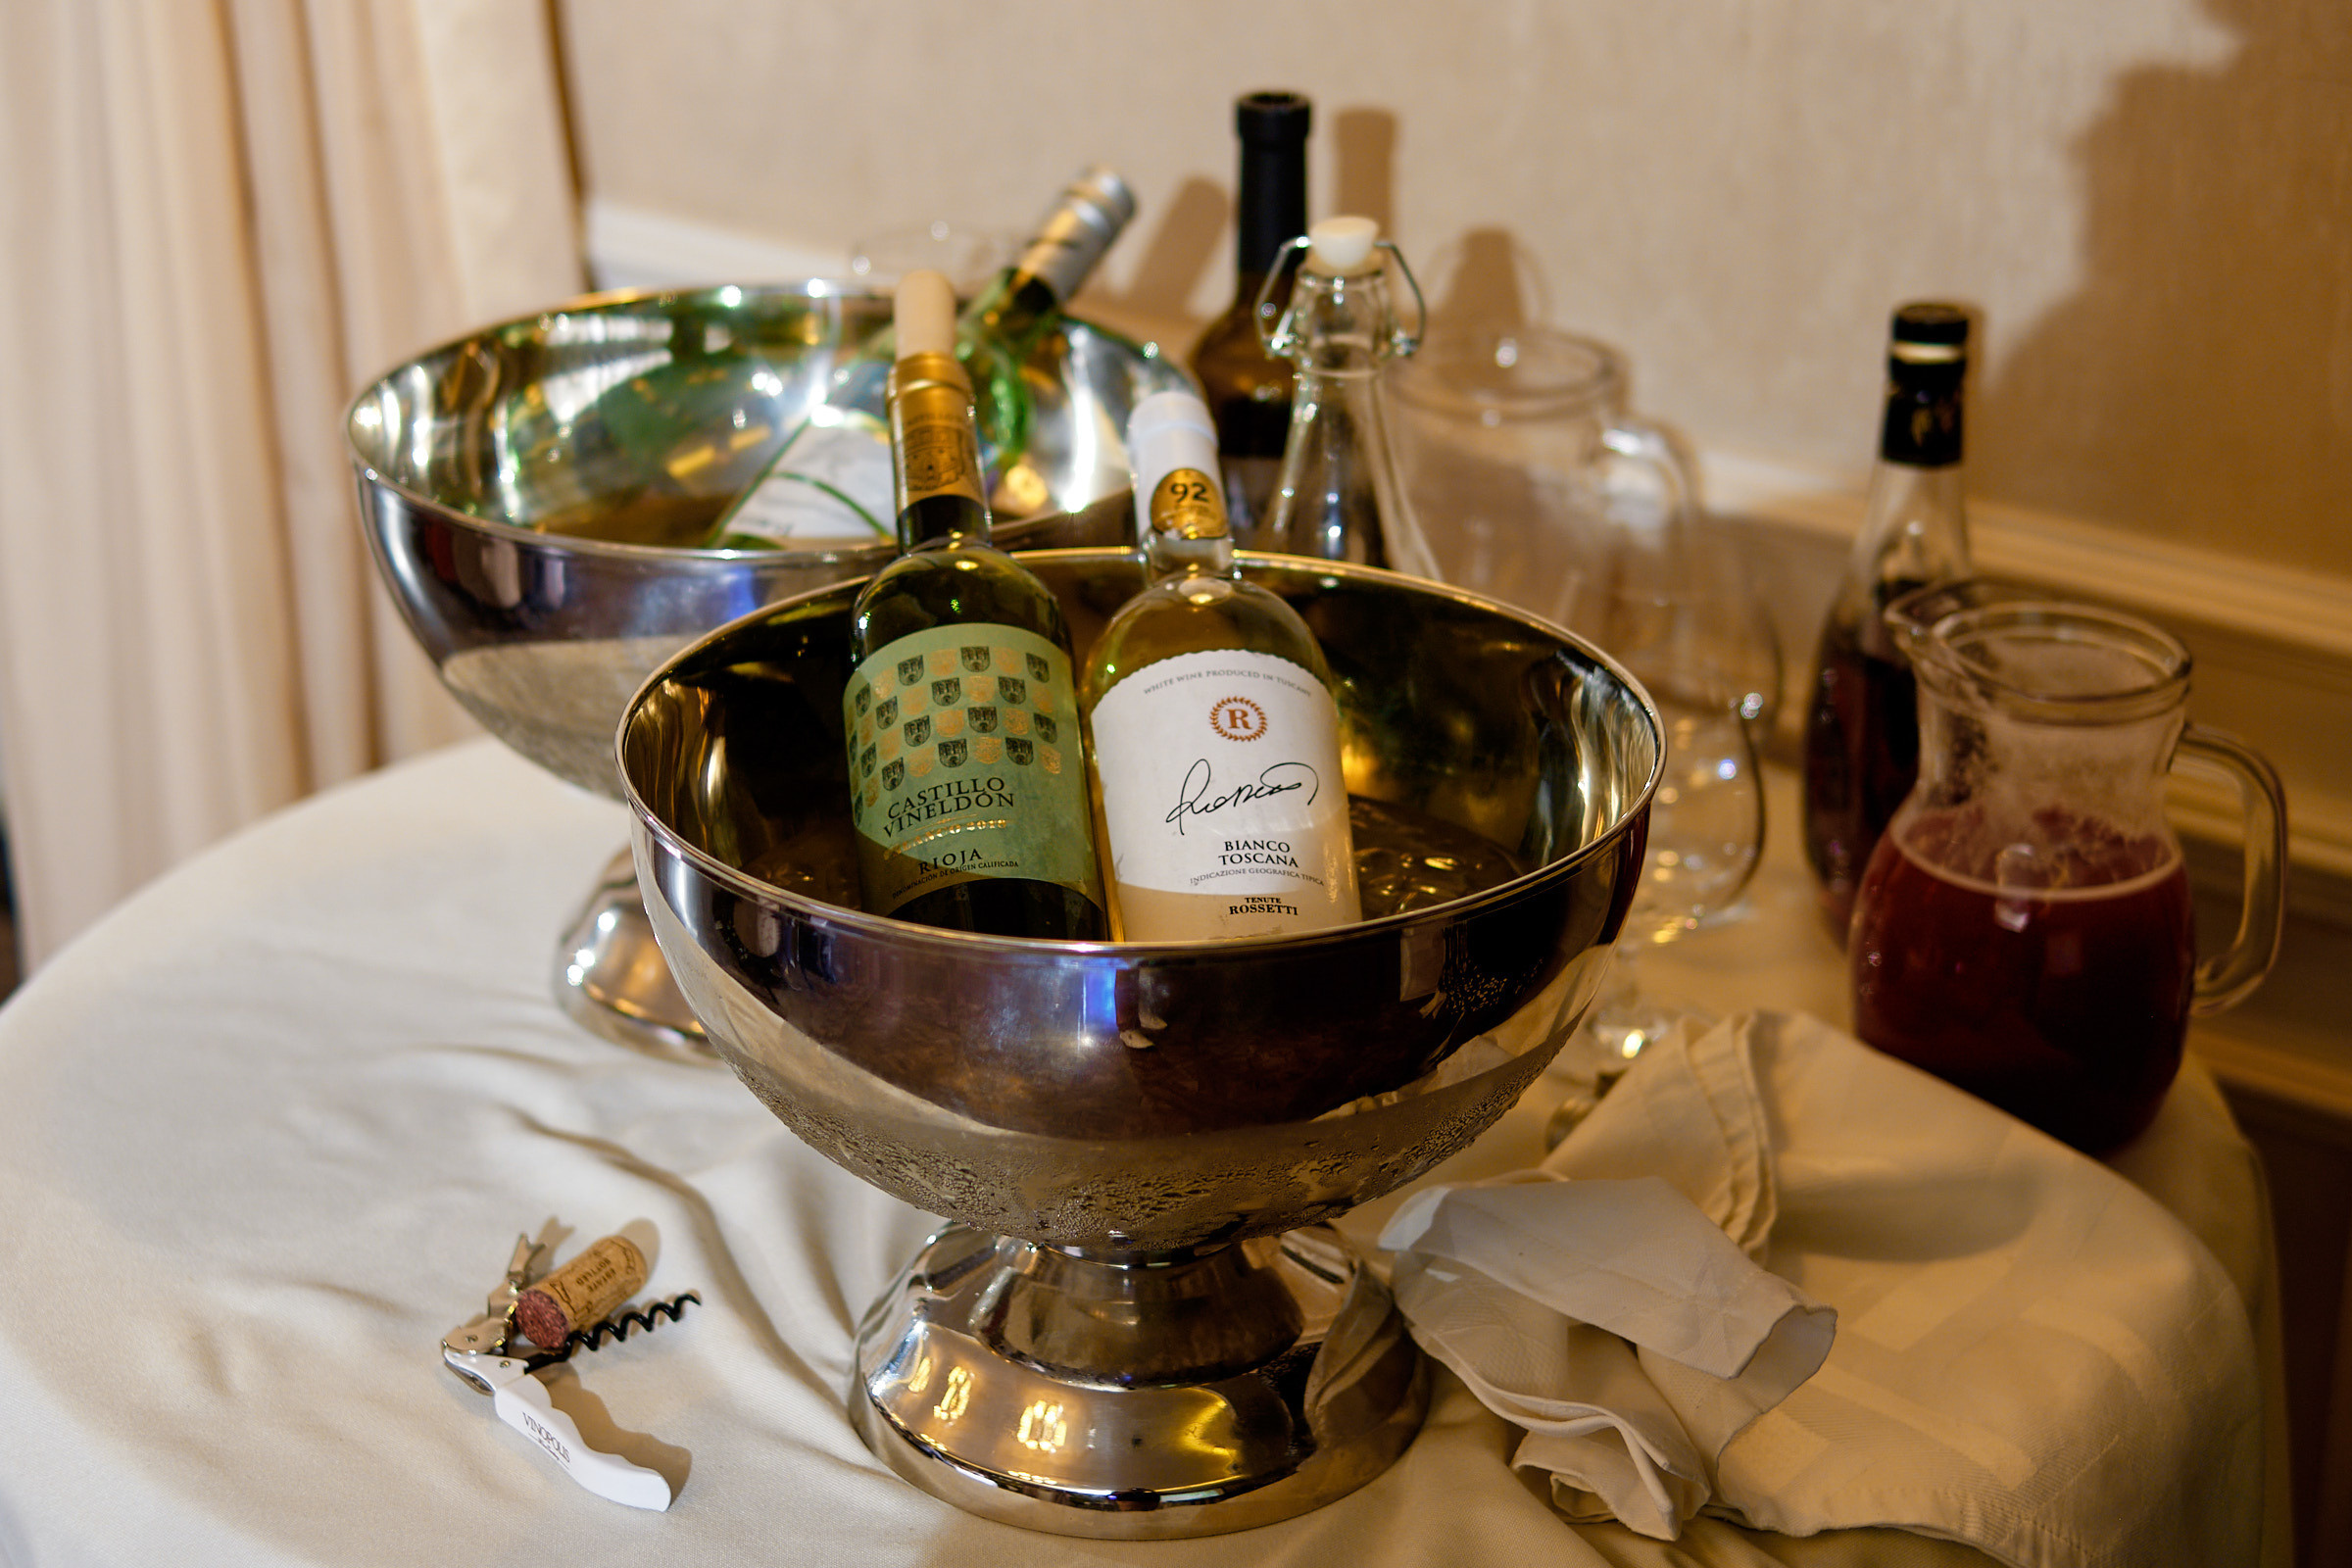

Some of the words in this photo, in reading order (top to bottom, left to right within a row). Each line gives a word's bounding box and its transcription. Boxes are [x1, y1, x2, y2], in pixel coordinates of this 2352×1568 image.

[1171, 482, 1209, 503] 92
[1144, 678, 1173, 694] WHITE
[1176, 671, 1202, 682] WINE
[1205, 669, 1260, 678] PRODUCED
[1226, 709, 1252, 730] R
[888, 777, 1005, 819] CASTILLO
[883, 791, 1015, 838] VINELDÓN
[1224, 840, 1291, 854] BIANCO
[918, 849, 983, 875] RIOJA
[940, 869, 949, 878] DE
[950, 864, 976, 875] ORIGEN
[978, 860, 1018, 869] CALIFICADA
[1218, 853, 1299, 868] TOSCANA
[1190, 868, 1247, 884] INDICAZIONE
[1248, 867, 1300, 879] GEOGRAFICA
[1300, 873, 1325, 887] TIPICA
[1229, 904, 1298, 916] ROSSETTI
[576, 1257, 611, 1286] BOTTLED
[522, 1411, 570, 1463] VINOPOLIS
